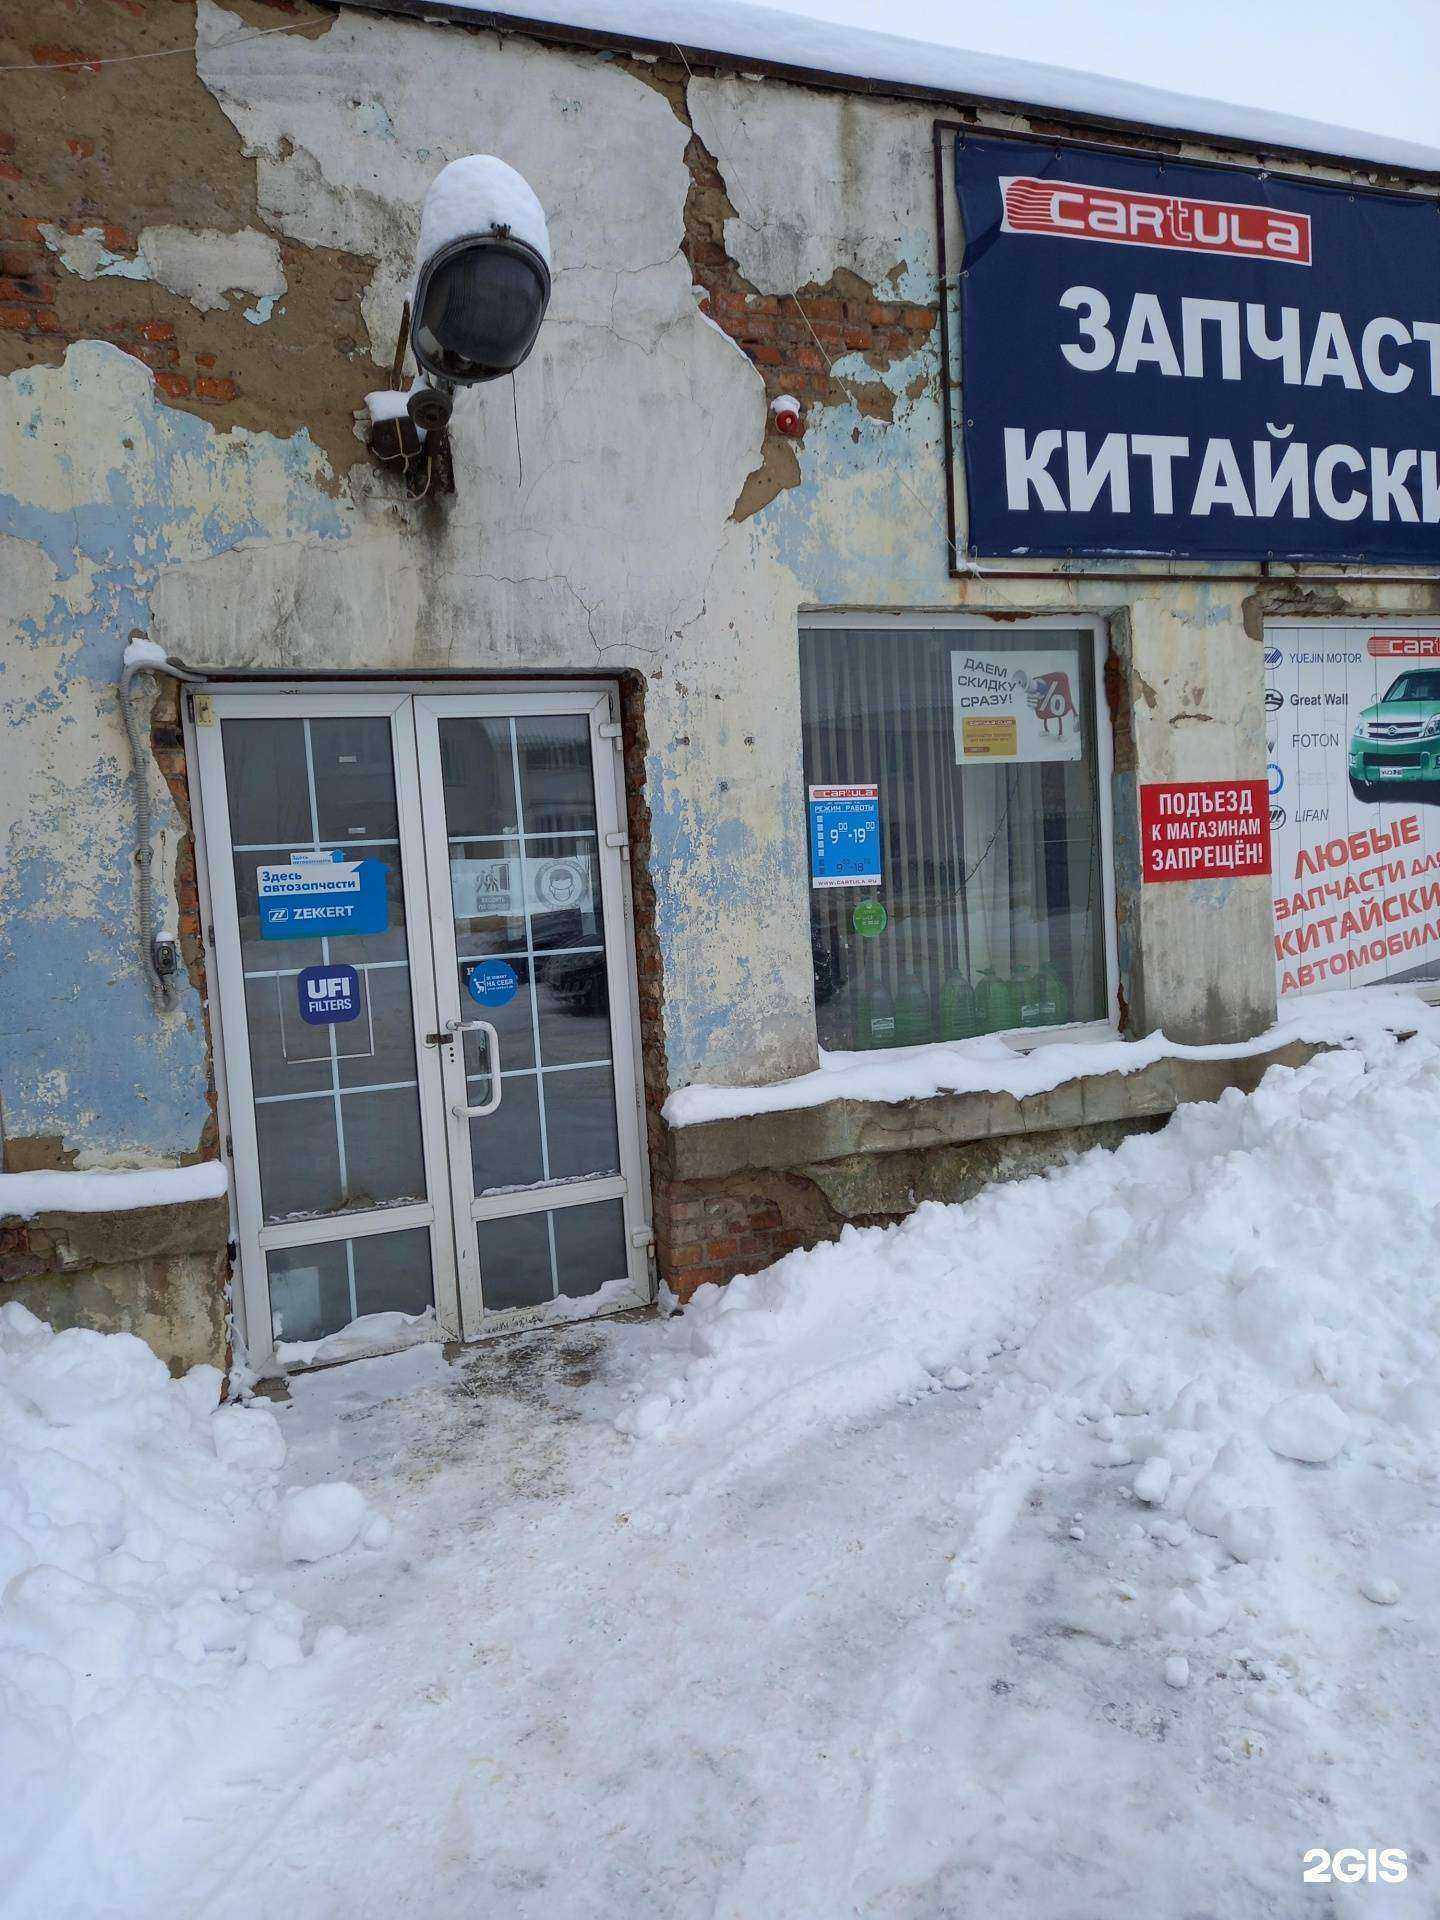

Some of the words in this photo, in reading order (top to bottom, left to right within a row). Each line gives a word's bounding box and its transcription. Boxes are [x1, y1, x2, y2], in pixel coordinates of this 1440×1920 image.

[1289, 653, 1324, 664] YUEJIN
[1326, 653, 1362, 663] MOTOR
[963, 658, 1008, 678] ДАЕМ
[958, 675, 1017, 692] СКИДКУ
[960, 694, 1013, 708] СРАЗУ!
[1290, 694, 1322, 706] Great
[1326, 693, 1348, 705] Wall
[1292, 733, 1339, 748] FOTON
[845, 804, 874, 812] РАБОТЫ
[1159, 789, 1253, 818] ПОДЪЕЗД
[1295, 809, 1329, 823] LIFAN
[1152, 824, 1161, 841] К
[1166, 818, 1261, 840] МАГАЗИНАМ
[1294, 815, 1421, 880] ЛЮБЫЕ
[1152, 840, 1263, 871] ЗАПРЕЩЁН!
[262, 871, 302, 882] Здесь
[263, 880, 356, 893] автозапчасти
[1274, 860, 1406, 921] ЗАПЧАСТИ
[1411, 851, 1440, 877] ДЛ
[293, 905, 354, 920] ZEKKERT
[1274, 882, 1440, 961] КИТАЙСКИ
[307, 977, 351, 999] UFI
[309, 999, 352, 1013] FILTERS
